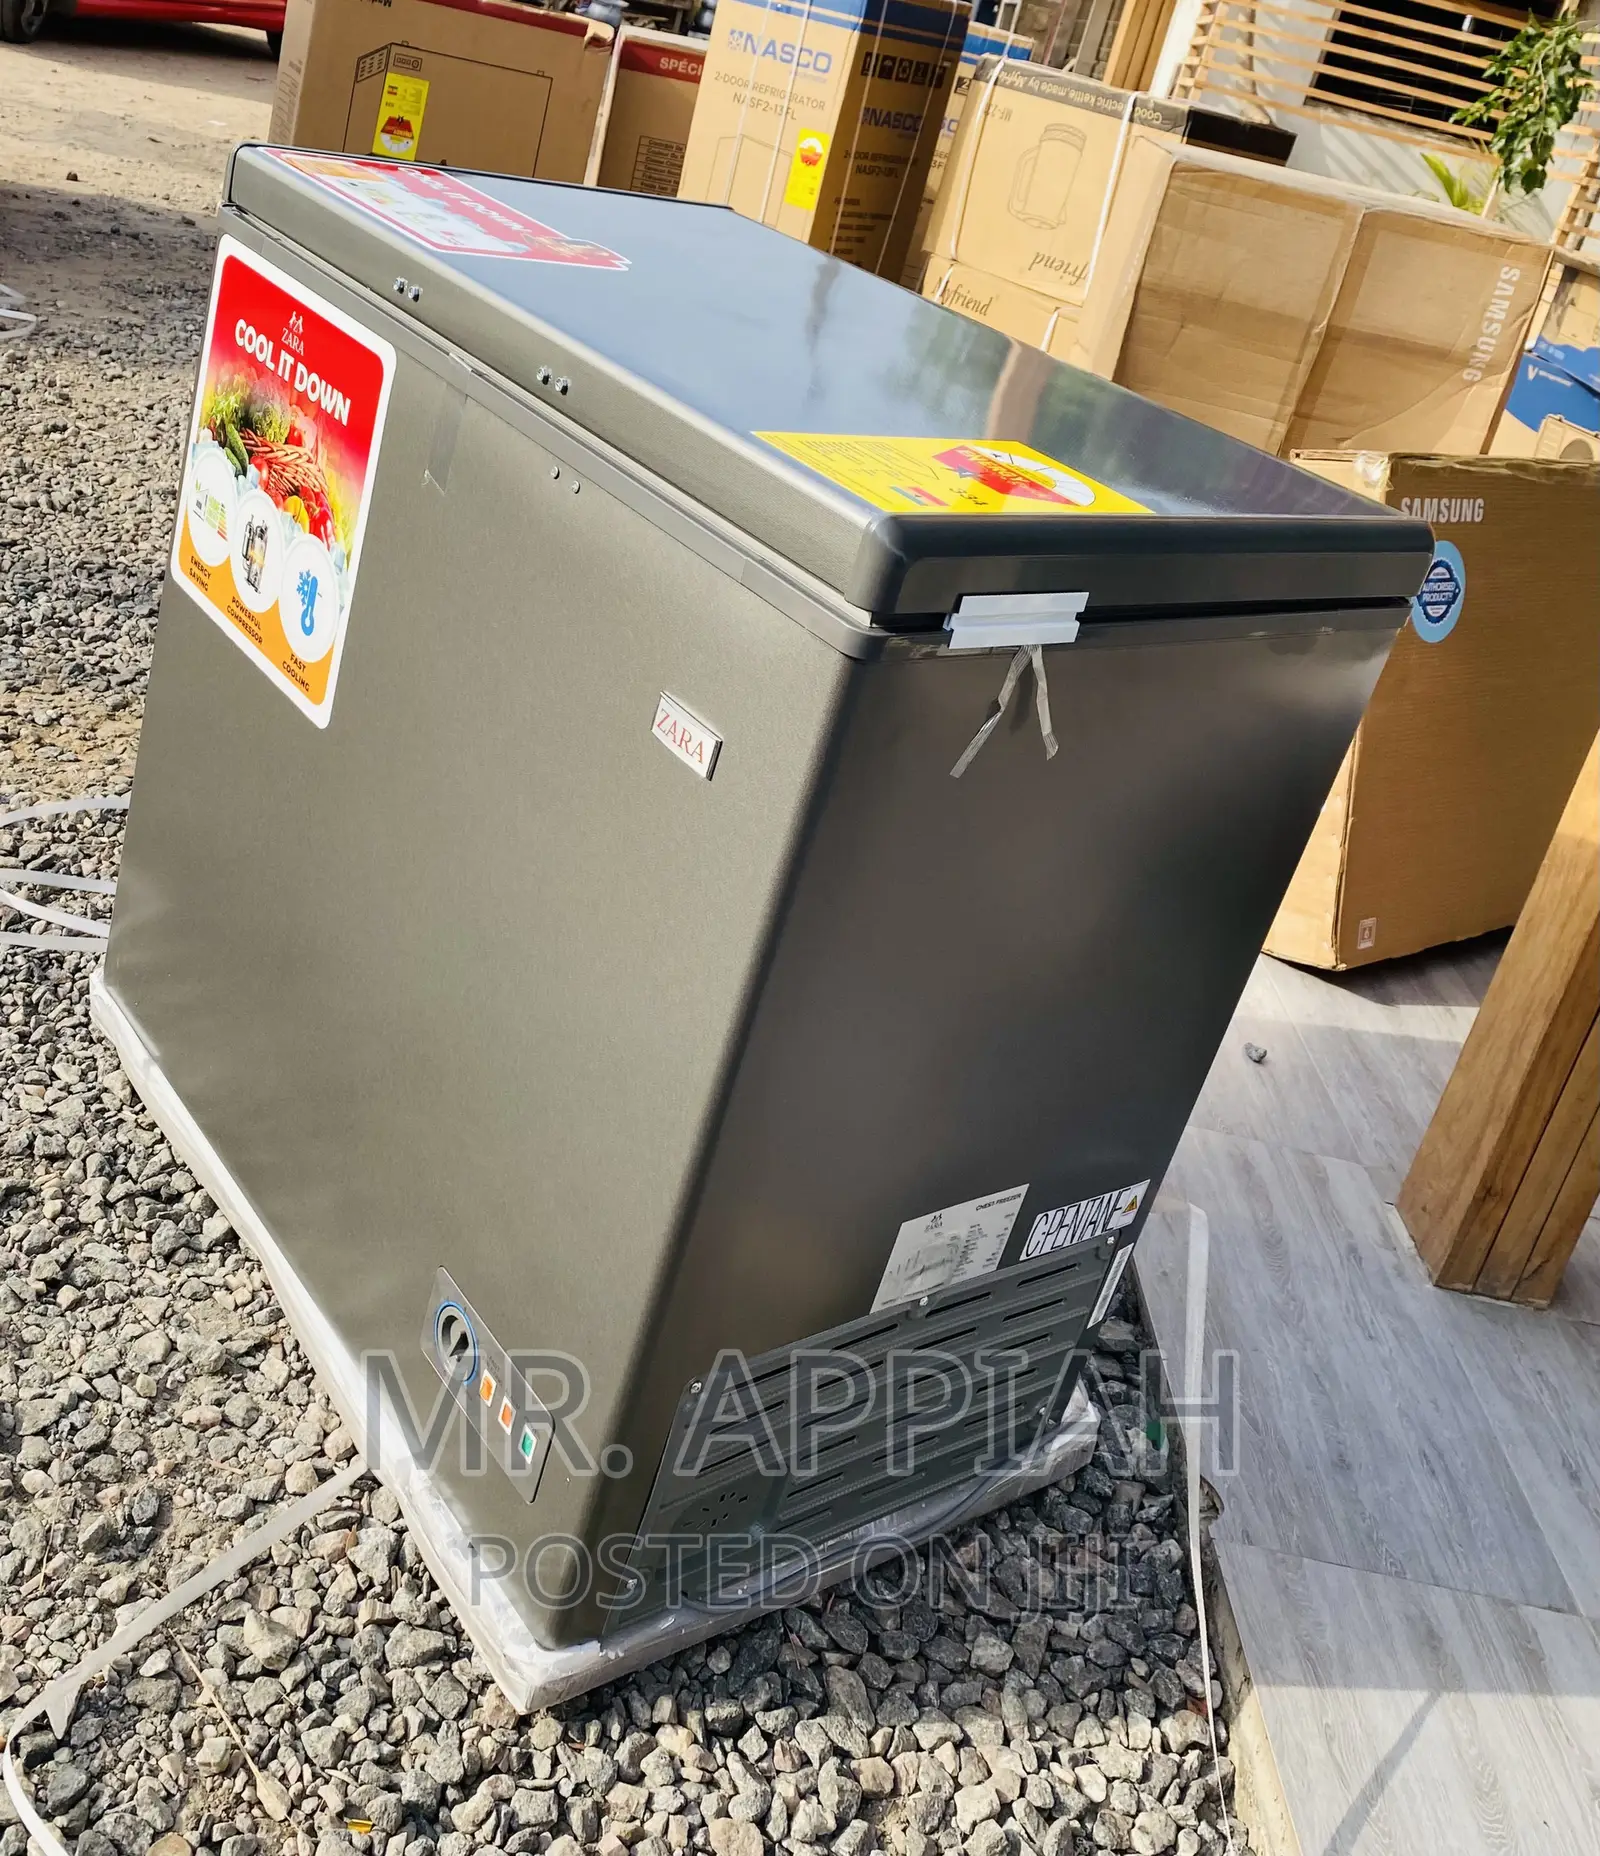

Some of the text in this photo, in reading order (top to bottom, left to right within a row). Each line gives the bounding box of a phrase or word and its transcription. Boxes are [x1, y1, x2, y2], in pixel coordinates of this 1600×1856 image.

[743, 32, 832, 74] NASCO
[714, 71, 826, 111] 2-DOOR REFRIGRATOR
[1028, 76, 1041, 92] by
[869, 107, 923, 132] NASCO
[1097, 96, 1127, 113] lectric
[1134, 107, 1162, 124] Good
[1028, 252, 1089, 286] friend
[1462, 266, 1521, 382] SAMSUNG
[282, 328, 304, 356] ZARA
[235, 318, 351, 427] COOL IT DOWN
[953, 449, 1031, 484] ENERGY
[1401, 497, 1484, 523] SAMSUNG
[189, 568, 209, 592] SAVING
[190, 556, 211, 579] ENERGY
[226, 605, 263, 645] COMPRESSOR
[231, 596, 261, 630] POWERFUL
[282, 661, 310, 692] COOLING
[290, 653, 306, 673] FAST
[657, 708, 703, 764] ZARA
[1025, 1188, 1131, 1257] C-PENTANE
